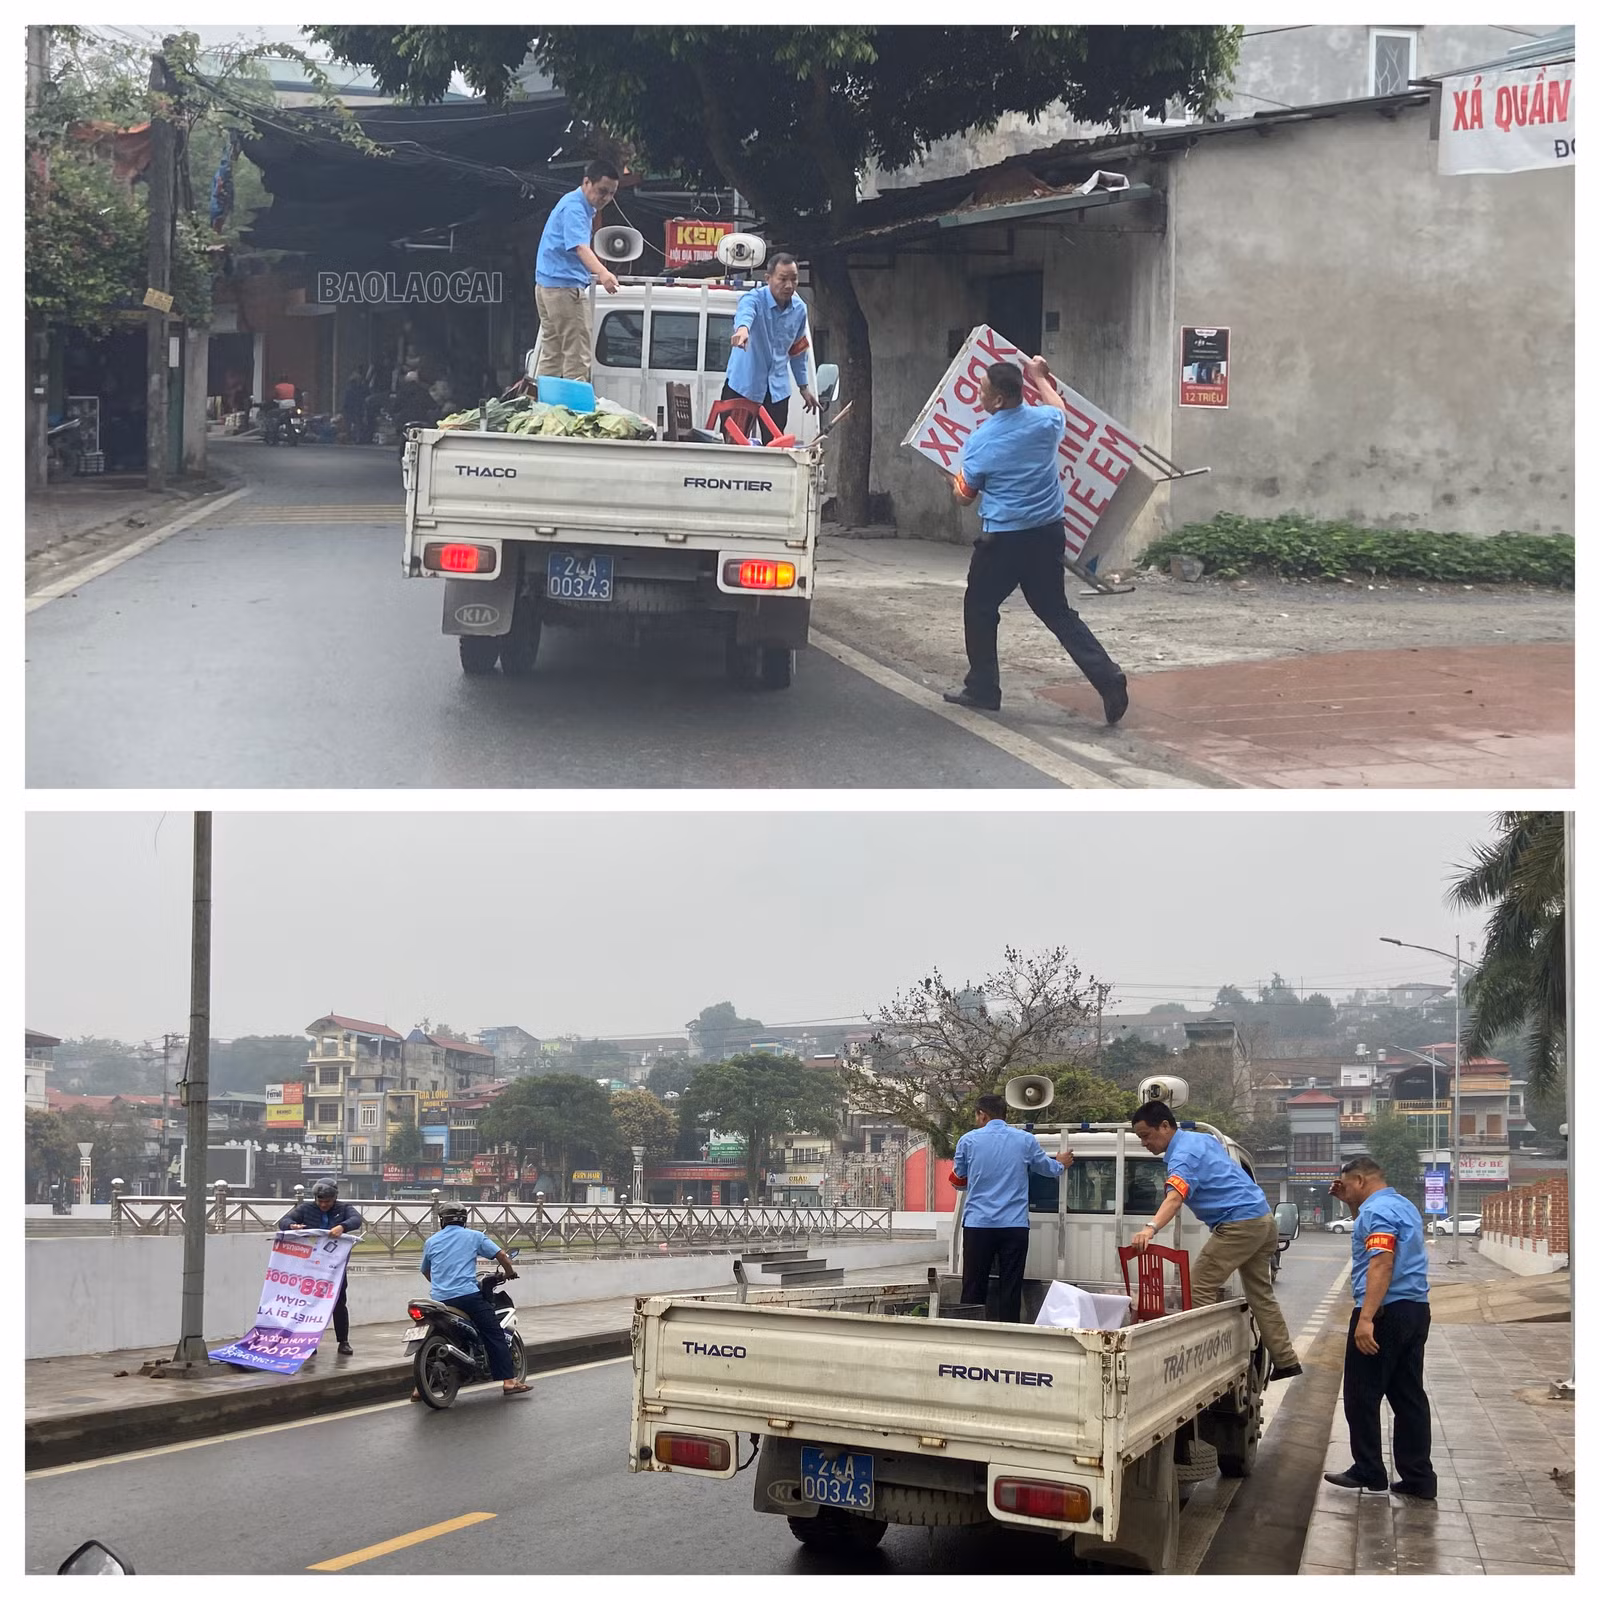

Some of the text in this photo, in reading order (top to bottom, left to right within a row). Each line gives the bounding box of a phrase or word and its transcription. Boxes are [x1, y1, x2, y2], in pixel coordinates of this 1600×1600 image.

[1452, 64, 1572, 132] XẢ QUẦN
[677, 226, 724, 246] KEM
[1185, 391, 1224, 404] 12 TRIỆU
[919, 398, 972, 466] XẢ
[1086, 424, 1141, 486] EM
[454, 465, 773, 492] THACO FRONTIER
[563, 556, 597, 577] 24A
[550, 576, 610, 598] 003.43
[462, 608, 492, 621] KIA
[431, 1090, 448, 1099] LONG
[264, 1307, 272, 1315] Y
[276, 1307, 289, 1317] BỊ
[292, 1312, 323, 1324] THIẾT
[280, 1346, 300, 1357] CÓ
[682, 1341, 1053, 1389] THACO FRONTIER
[1163, 1344, 1193, 1384] TRẬT
[804, 1476, 871, 1507] 003.43
